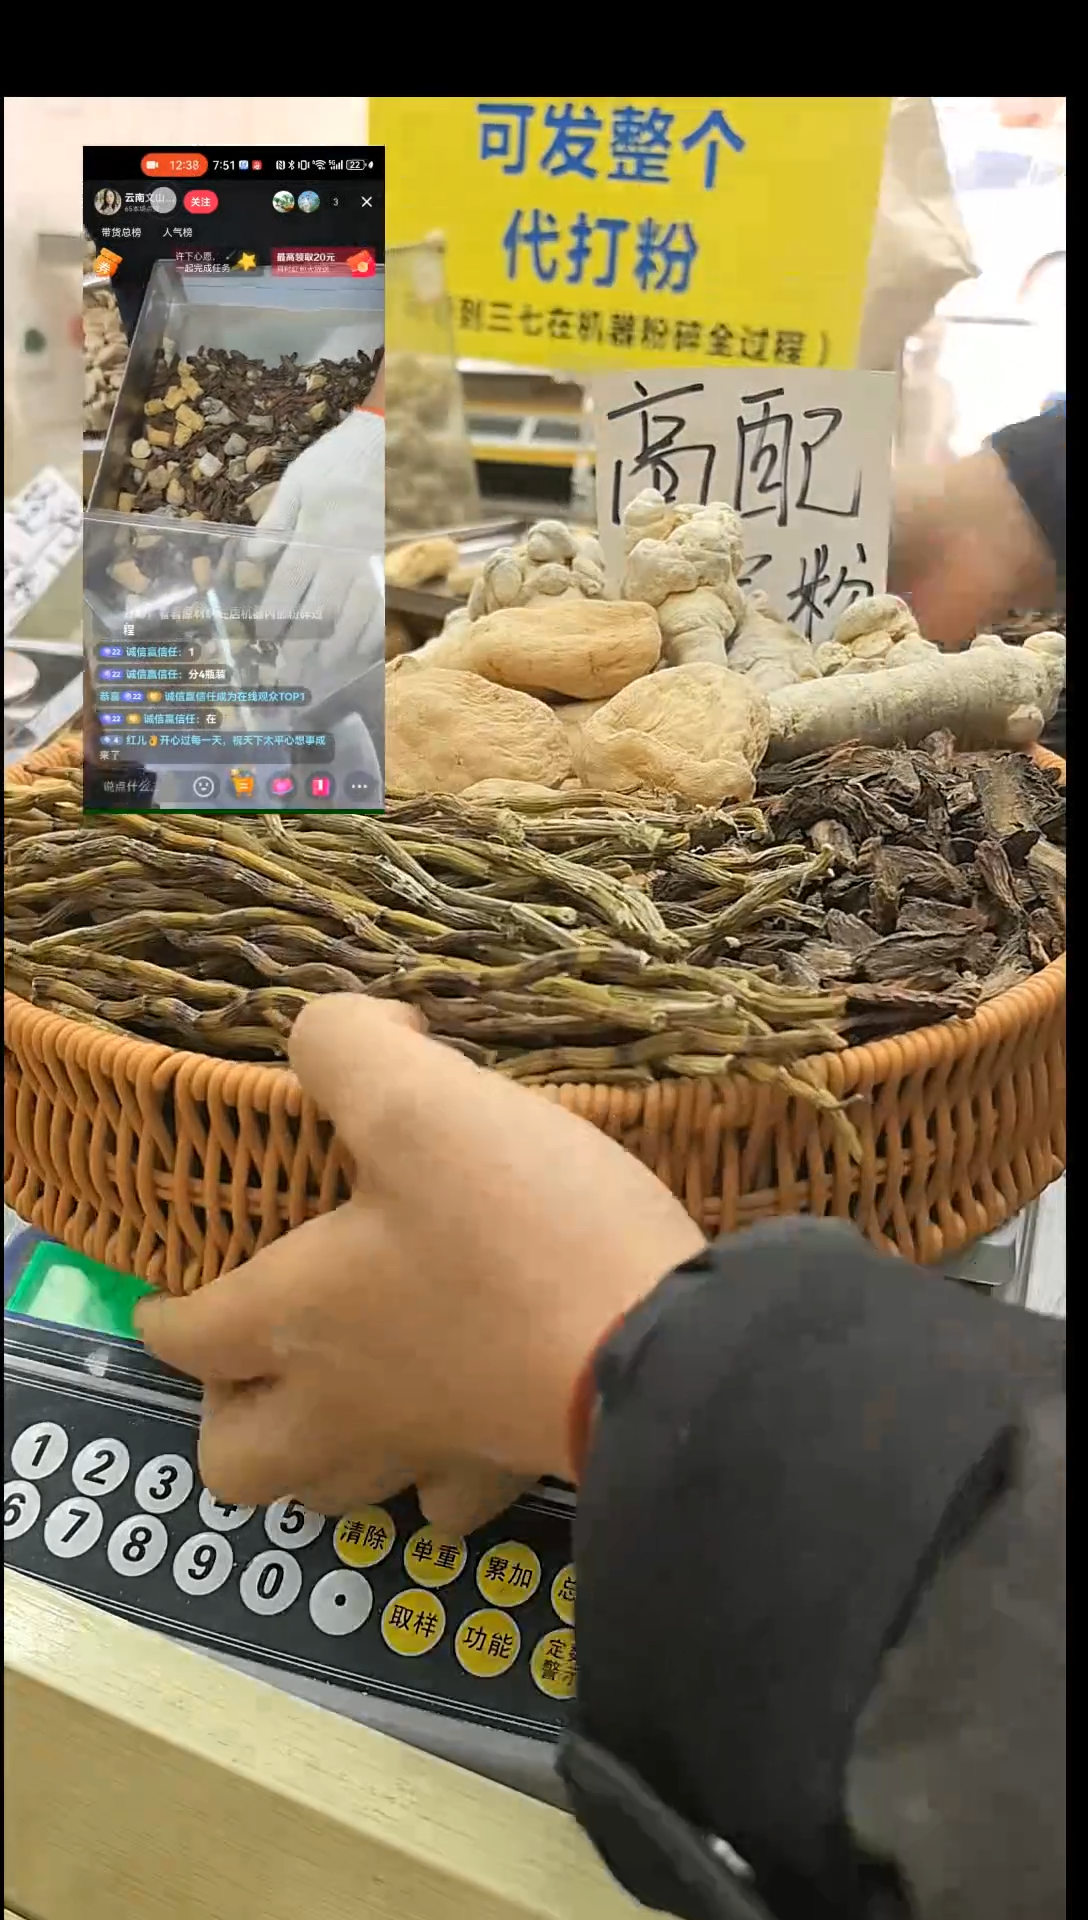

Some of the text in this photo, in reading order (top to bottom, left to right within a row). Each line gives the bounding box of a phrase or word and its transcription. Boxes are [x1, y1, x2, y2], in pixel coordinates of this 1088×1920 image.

[476, 103, 745, 189] 可发整个
[503, 209, 698, 293] 代打粉
[403, 292, 830, 366] 到三七在机器粉碎全过程）
[608, 381, 862, 526] 高配
[31, 1433, 53, 1467] 1
[85, 1449, 115, 1485] 2
[149, 1464, 179, 1501] 3
[65, 1508, 91, 1543] 7
[280, 1499, 305, 1534] 5
[123, 1526, 153, 1563] 8
[340, 1520, 388, 1550] 清除
[187, 1543, 218, 1580] 9
[410, 1537, 461, 1571] 单重
[485, 1554, 535, 1590] 累加
[256, 1562, 285, 1600] 0
[390, 1603, 441, 1639] 取样
[462, 1625, 515, 1660] 功能
